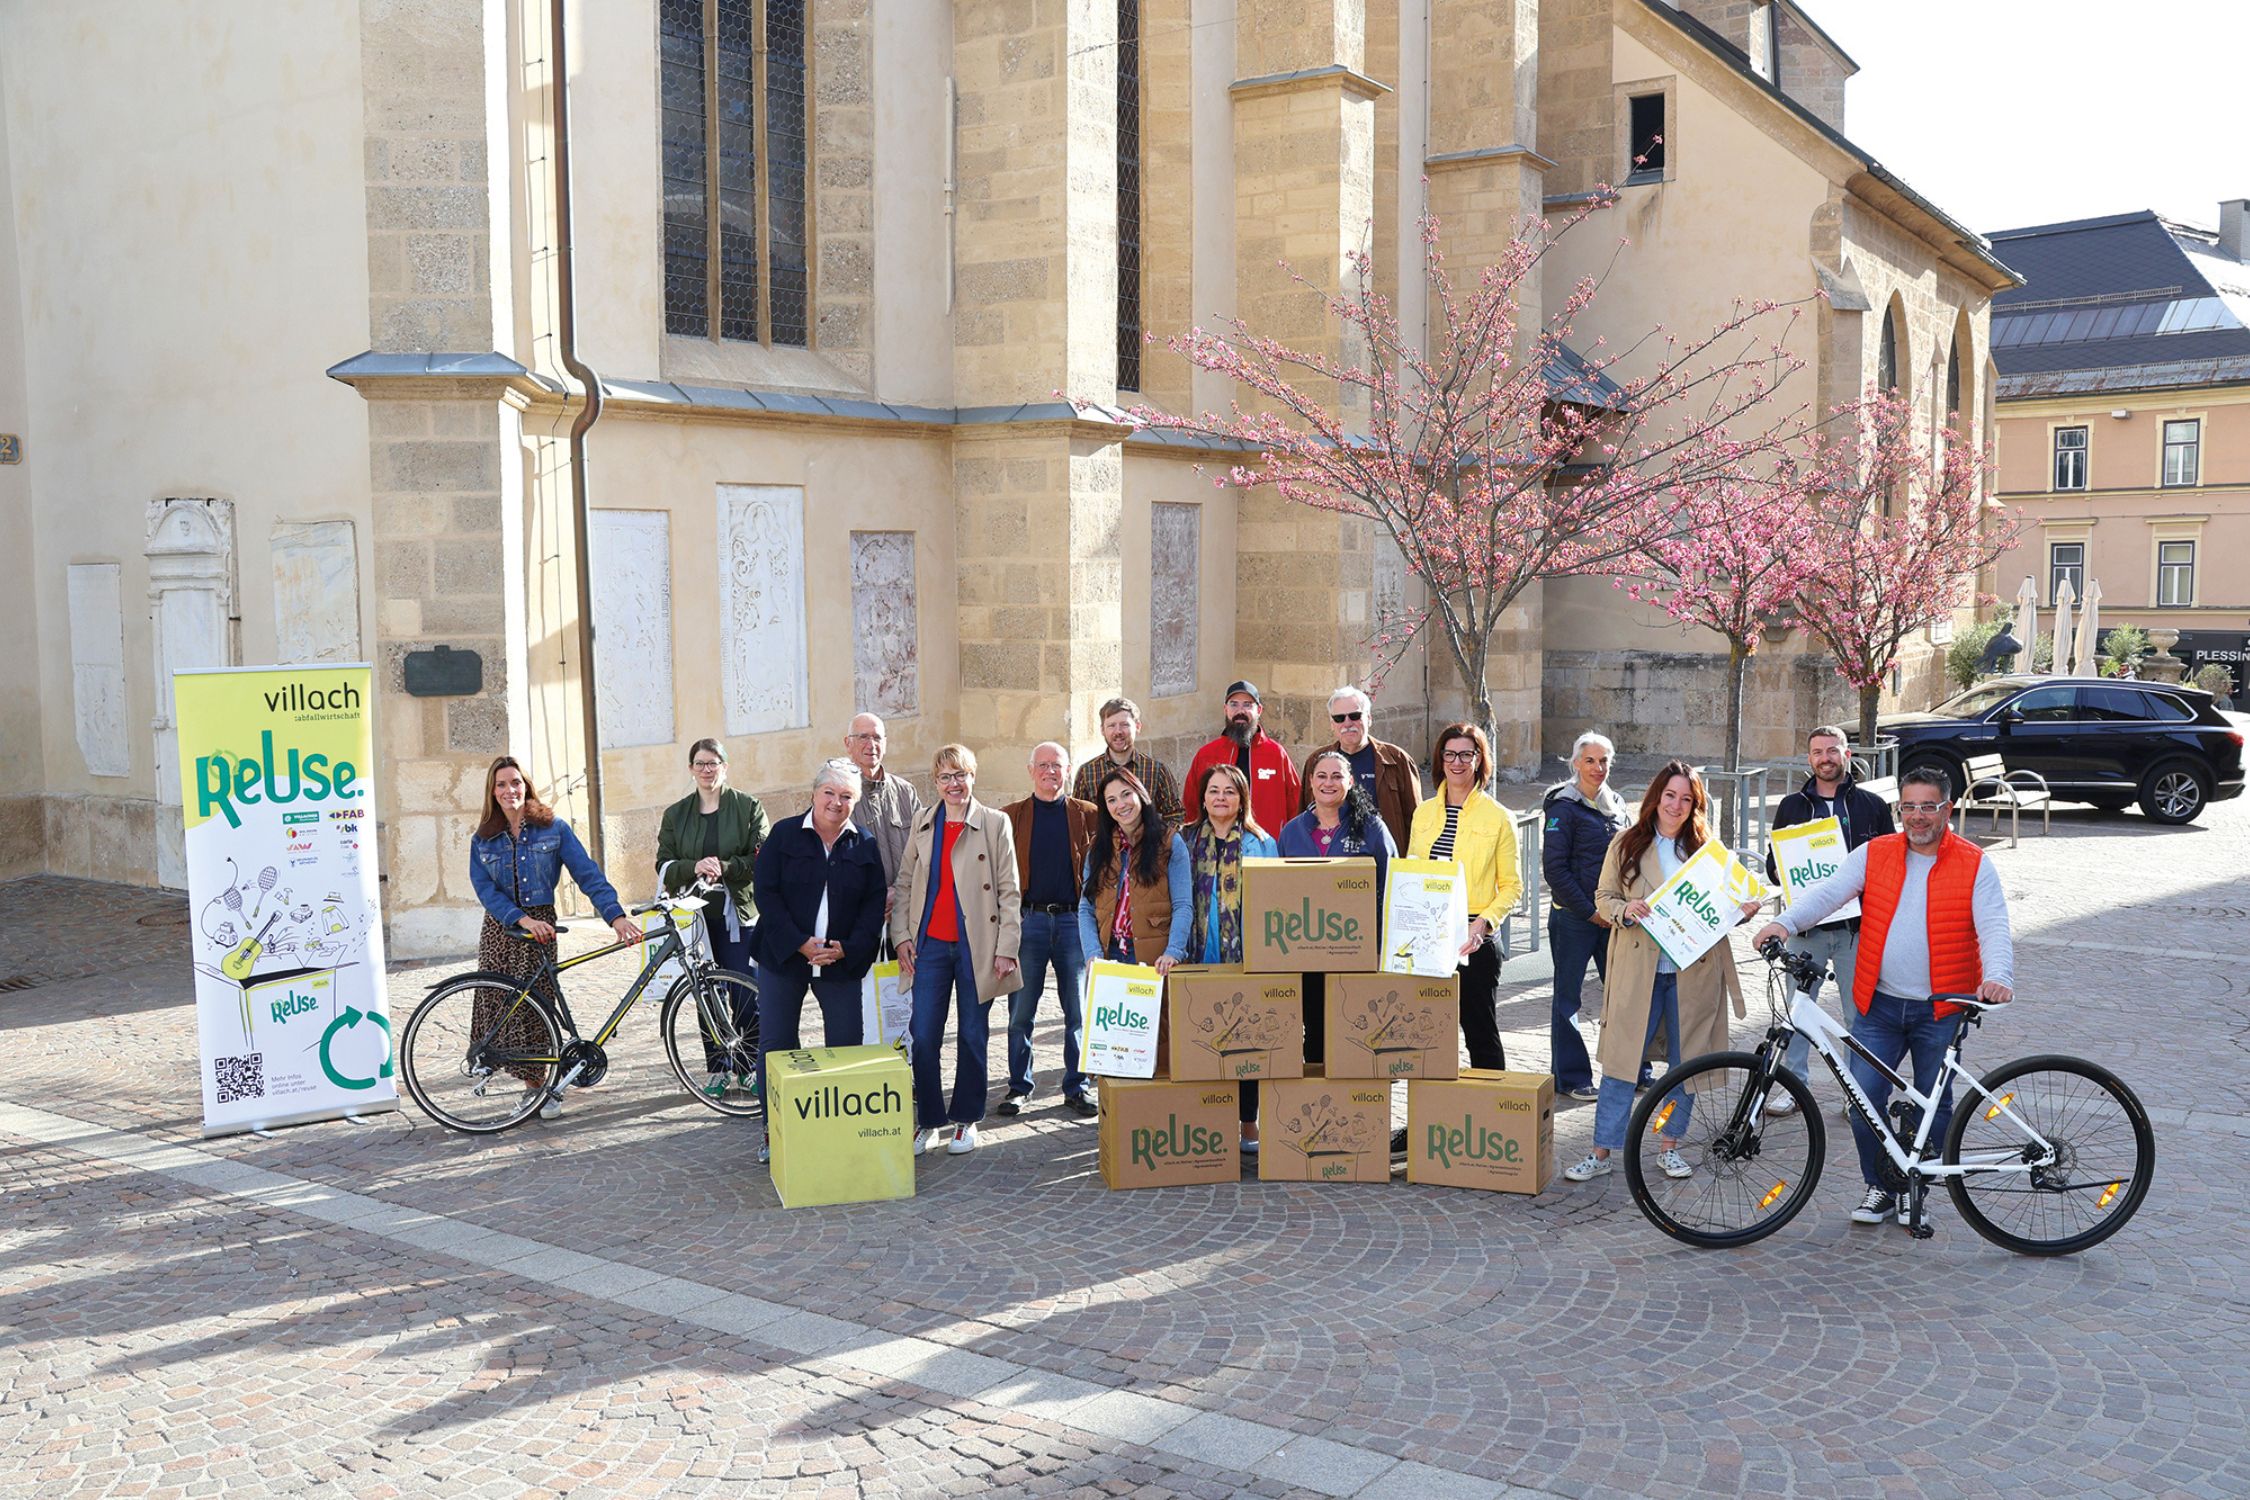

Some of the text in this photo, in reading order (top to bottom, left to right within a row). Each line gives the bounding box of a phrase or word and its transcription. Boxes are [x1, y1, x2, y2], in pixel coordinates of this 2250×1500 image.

[264, 682, 360, 712] villach
[343, 809, 365, 819] FAB
[1811, 837, 1836, 848] villach
[1337, 879, 1370, 889] villach
[1425, 882, 1451, 891] villach
[1128, 985, 1155, 996] villach
[1264, 988, 1296, 998] villach
[1419, 987, 1452, 998] villach
[794, 1082, 901, 1120] villach
[1202, 1093, 1233, 1104] villach
[1352, 1092, 1384, 1102] villach
[1499, 1101, 1531, 1111] villach
[857, 1127, 901, 1138] villach.at
